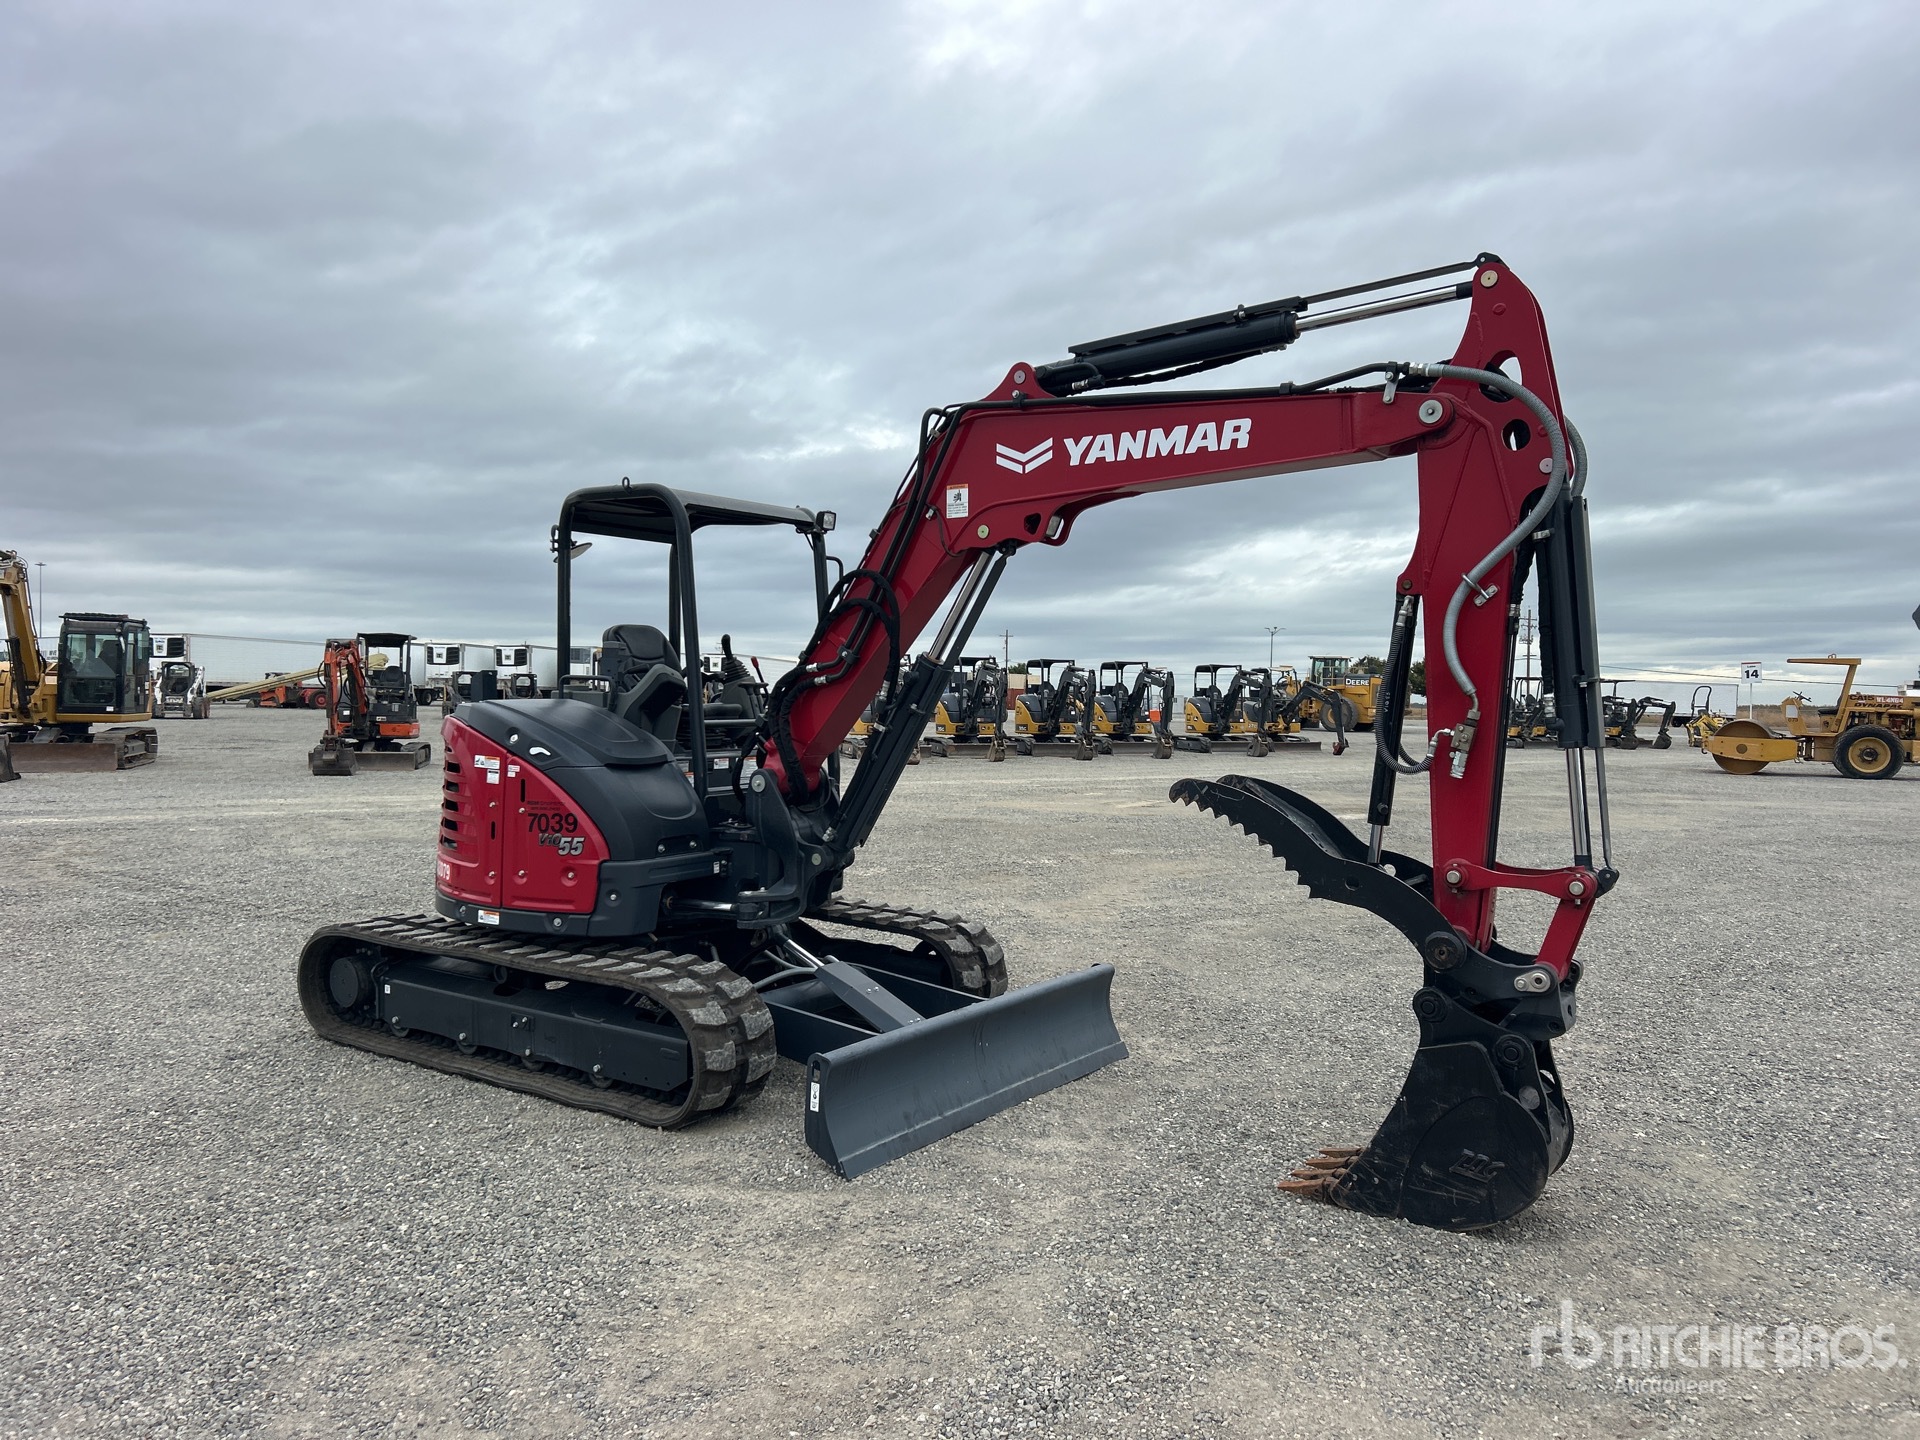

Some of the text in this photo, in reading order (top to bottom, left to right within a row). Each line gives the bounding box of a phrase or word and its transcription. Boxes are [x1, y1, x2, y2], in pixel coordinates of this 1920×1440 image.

[1063, 418, 1252, 466] YANMAR
[1345, 678, 1370, 686] DEERE
[1744, 669, 1759, 679] 14
[527, 812, 578, 834] 7039
